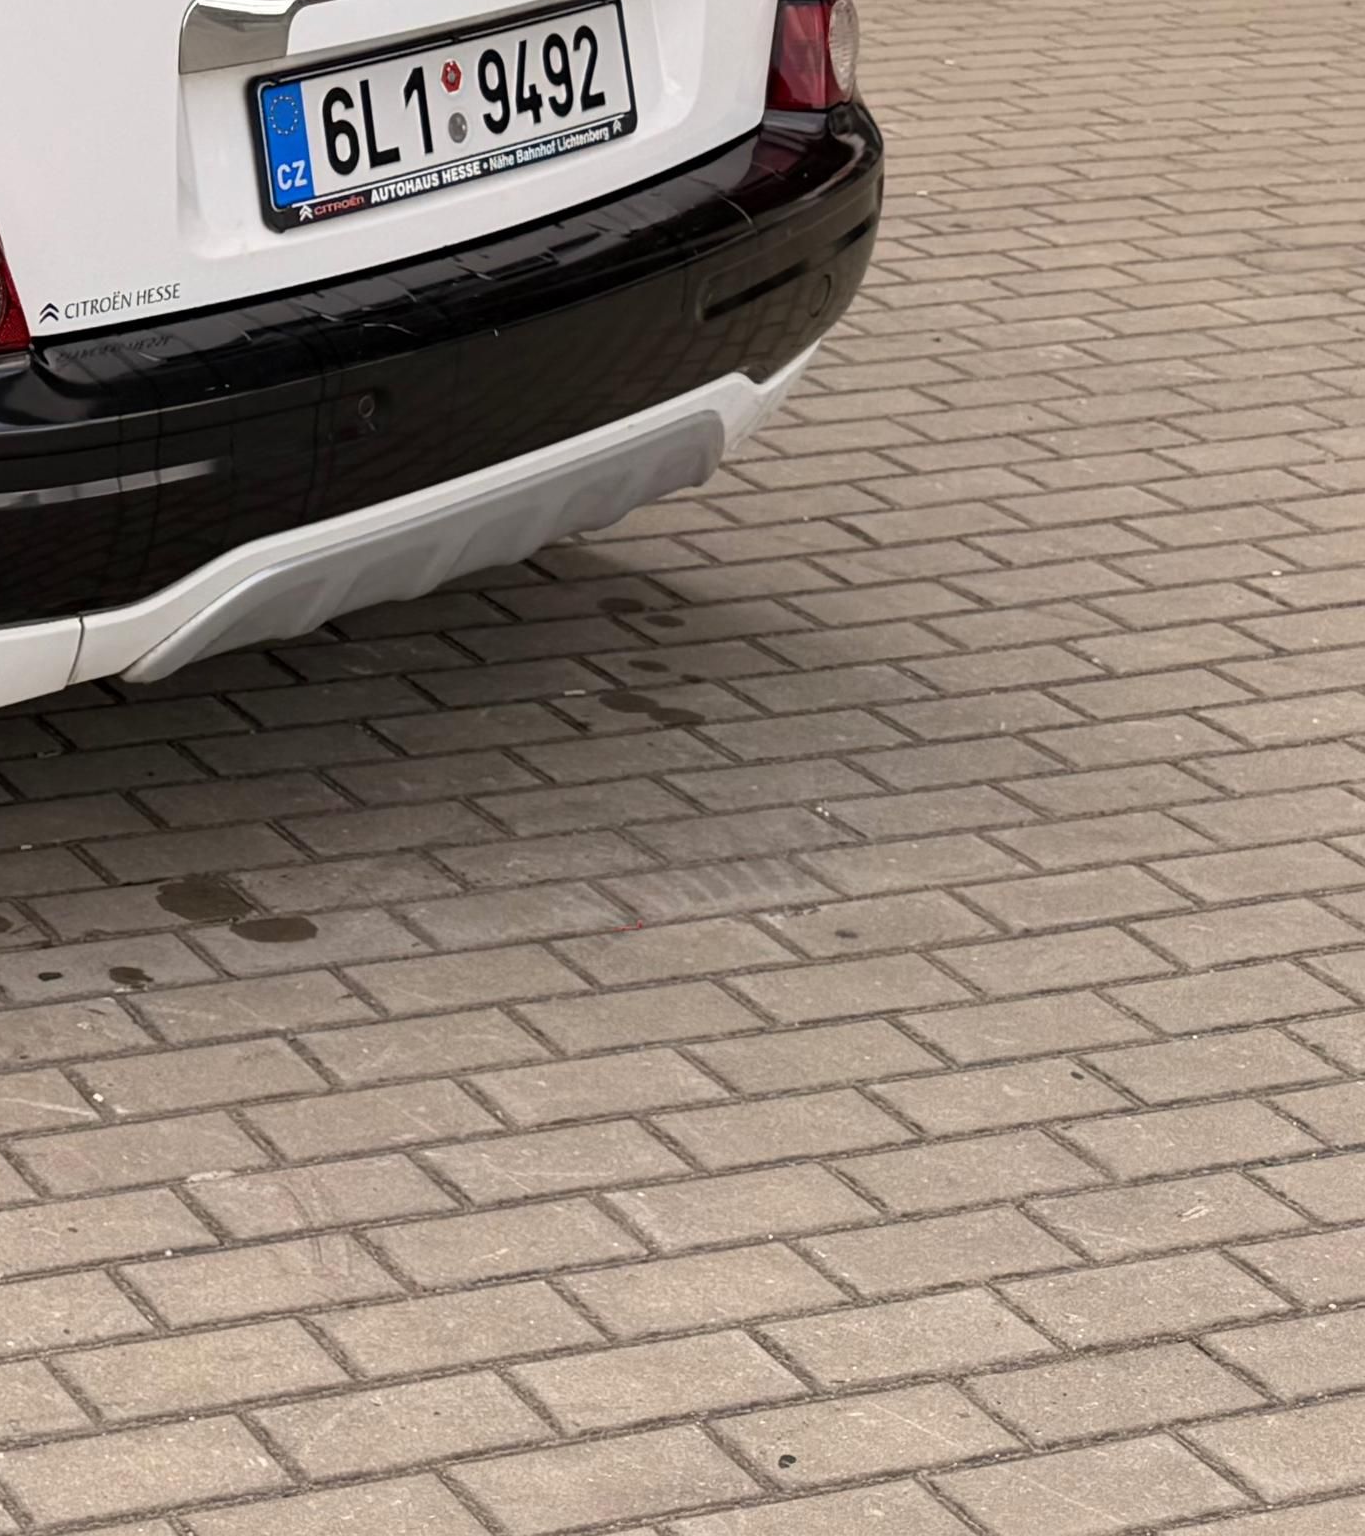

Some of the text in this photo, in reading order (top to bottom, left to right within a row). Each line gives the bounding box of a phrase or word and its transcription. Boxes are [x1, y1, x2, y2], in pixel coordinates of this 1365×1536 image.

[322, 24, 606, 176] 6L1 9492
[277, 160, 308, 192] CZ
[370, 173, 440, 205] AUTOHAUS
[442, 160, 482, 184] HESSE
[516, 142, 557, 164] Bahnhof
[557, 126, 610, 153] Lichtenberg
[64, 282, 182, 320] CITROËN HESSE
